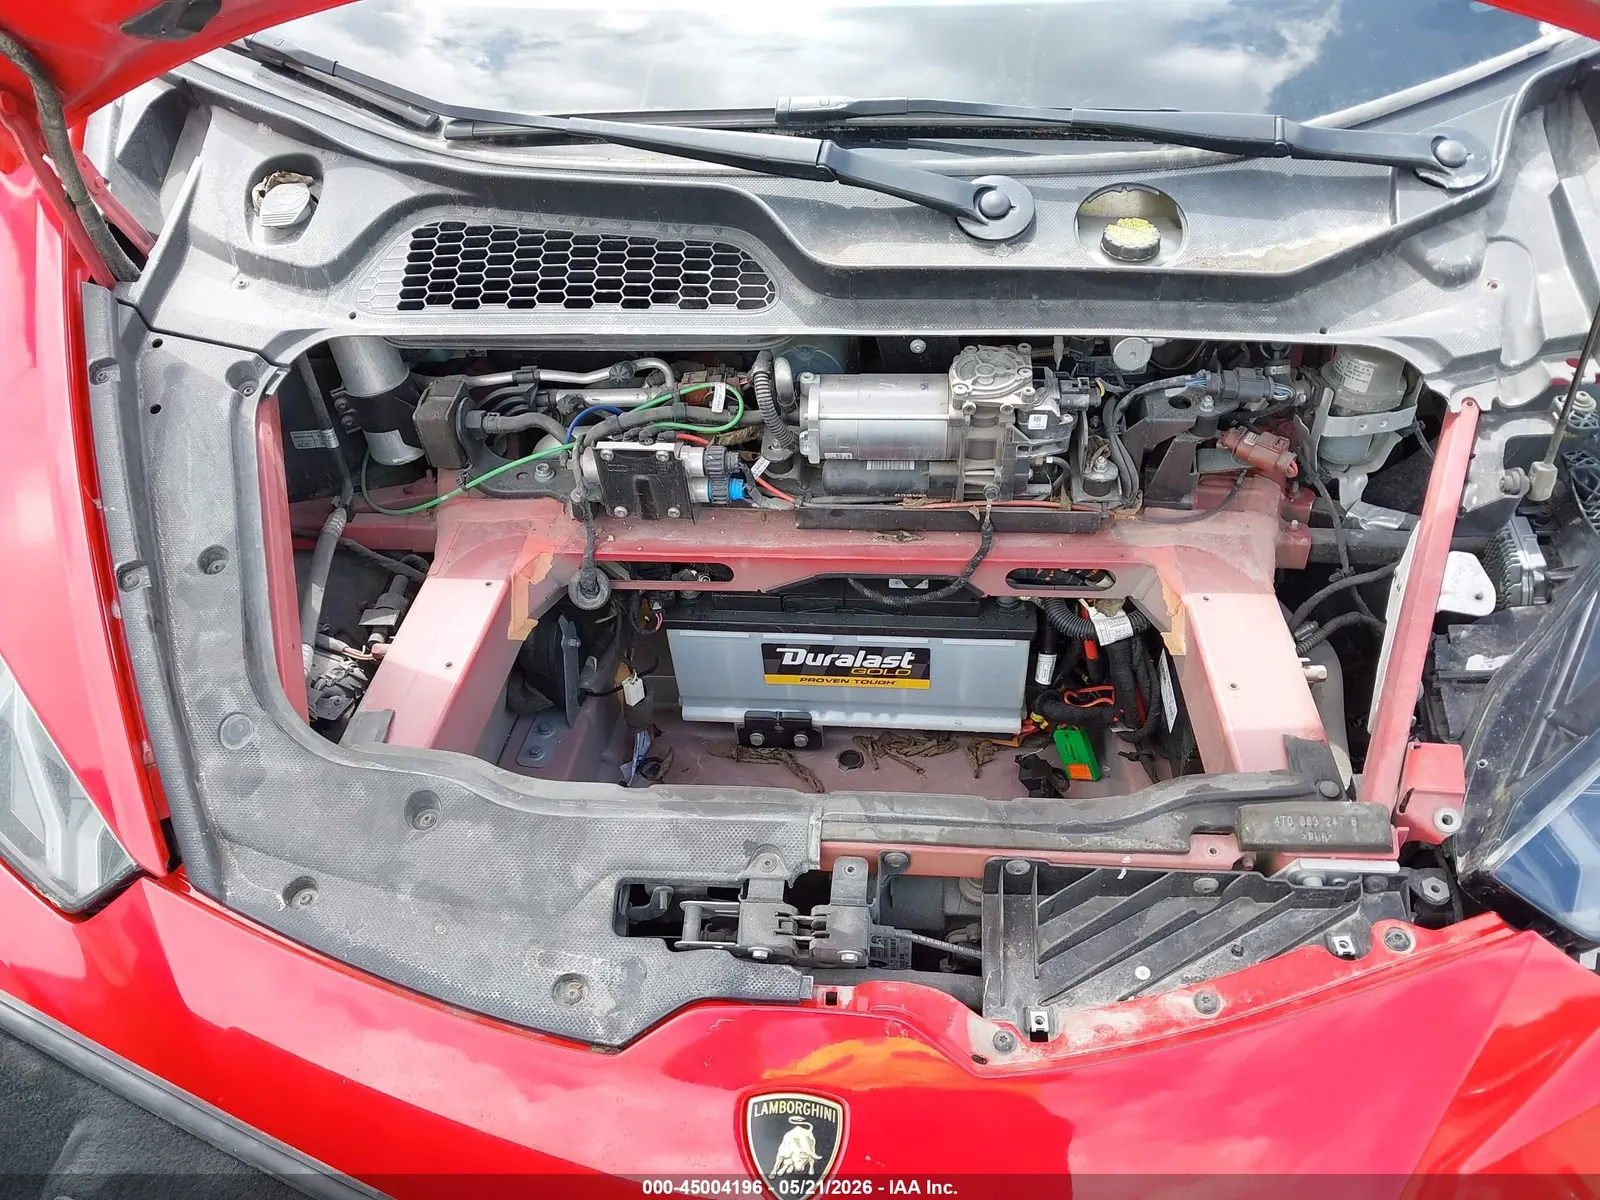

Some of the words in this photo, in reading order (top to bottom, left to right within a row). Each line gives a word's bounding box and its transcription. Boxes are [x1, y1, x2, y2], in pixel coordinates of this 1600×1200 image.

[776, 648, 915, 668] Duralast
[851, 668, 911, 676] GOLD
[754, 1101, 836, 1124] LAMBORGHINI
